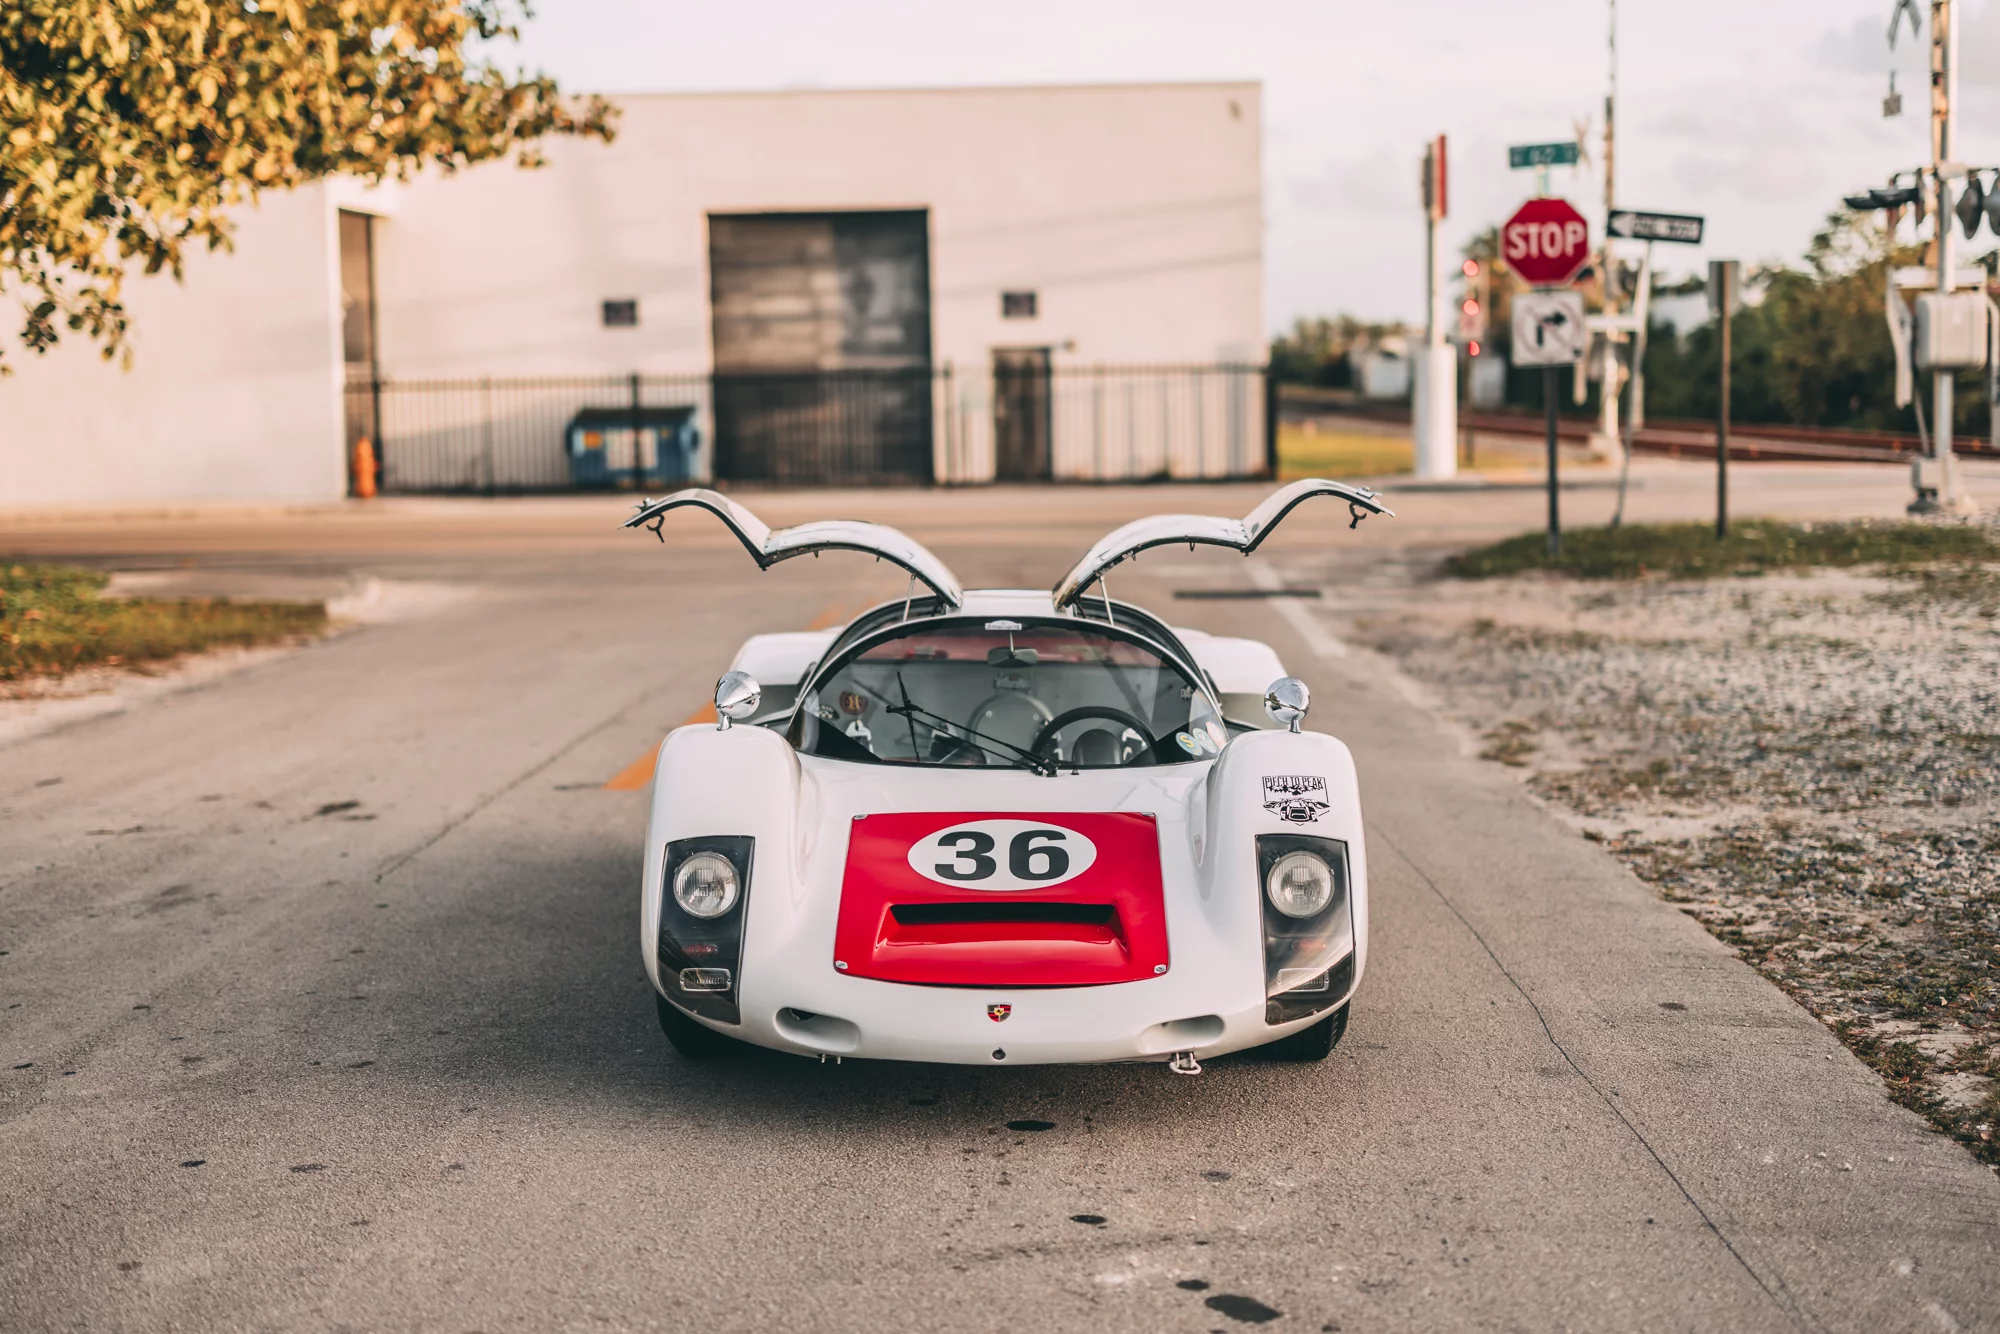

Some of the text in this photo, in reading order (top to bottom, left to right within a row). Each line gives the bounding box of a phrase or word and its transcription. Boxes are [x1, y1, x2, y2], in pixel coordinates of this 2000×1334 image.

[1507, 221, 1585, 260] STOP
[1290, 777, 1300, 787] TO
[1302, 777, 1323, 790] PEAK
[935, 829, 1069, 881] 36
